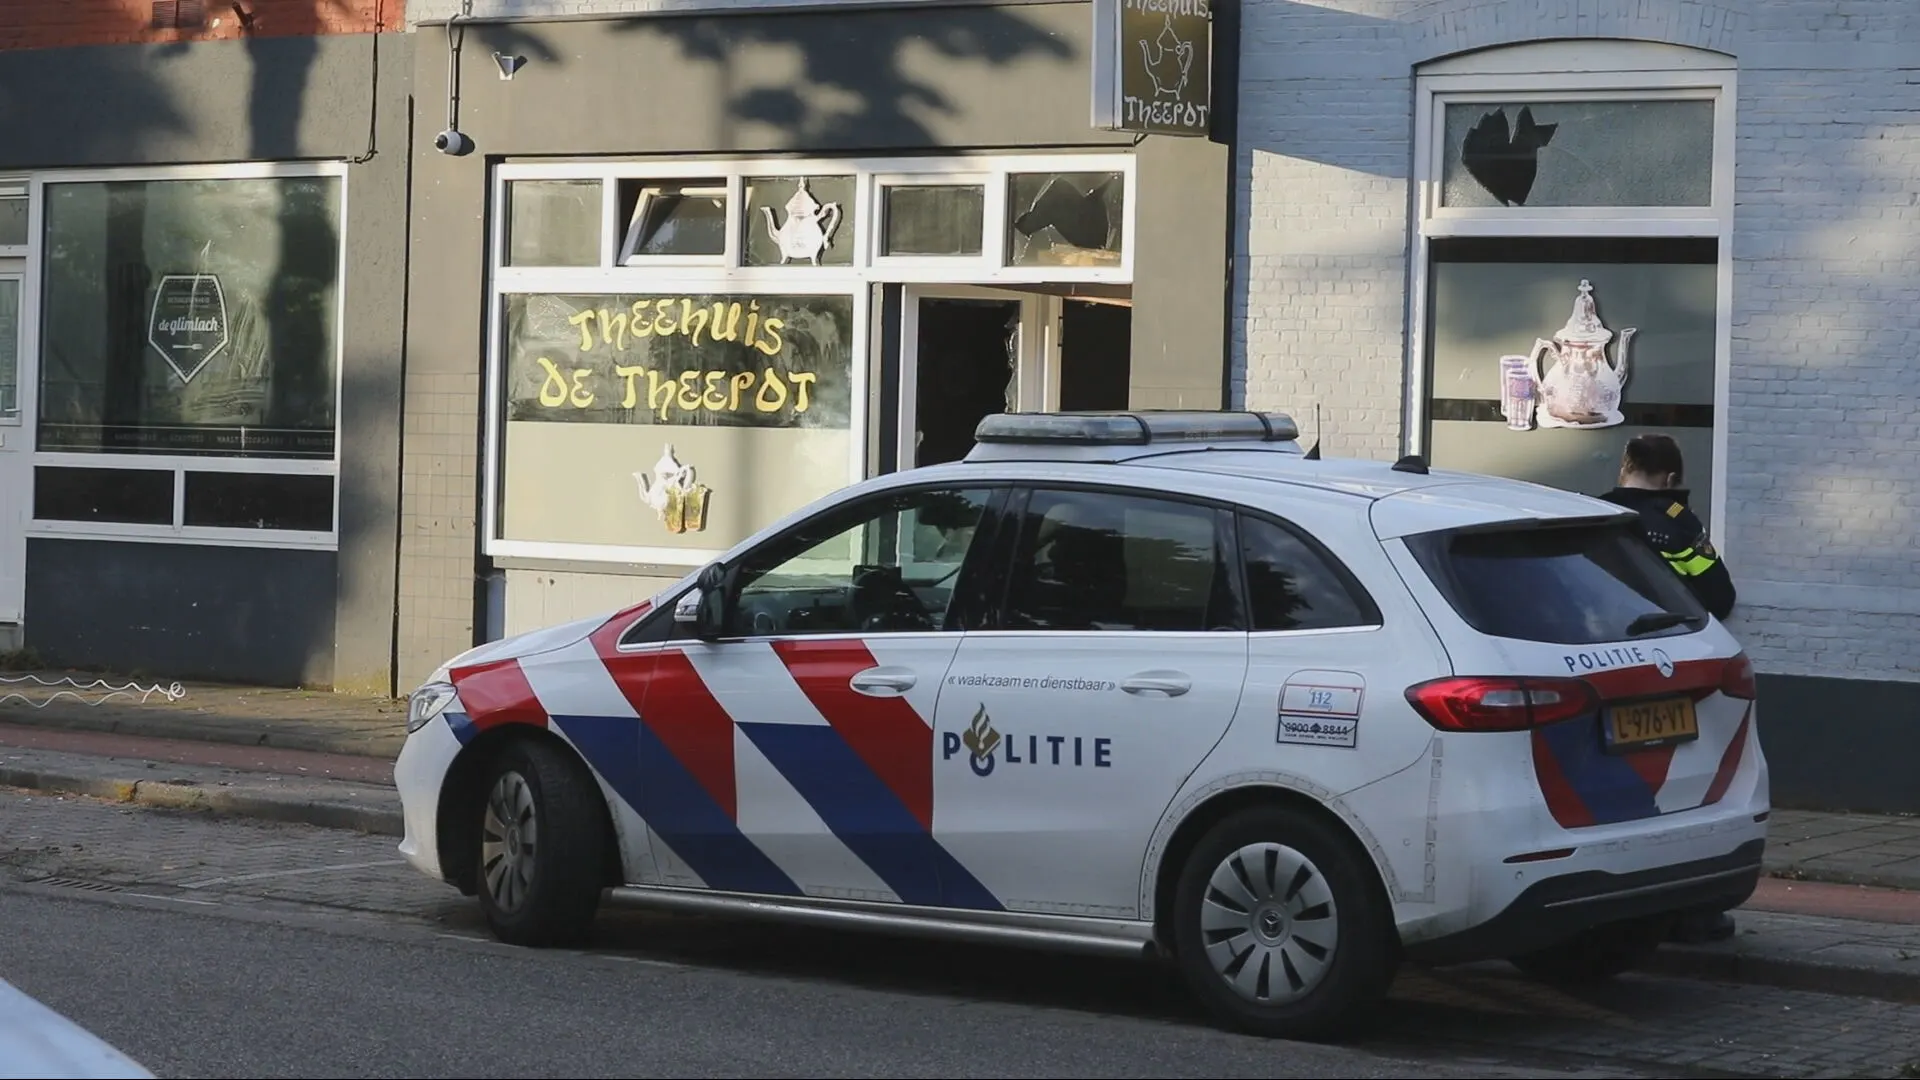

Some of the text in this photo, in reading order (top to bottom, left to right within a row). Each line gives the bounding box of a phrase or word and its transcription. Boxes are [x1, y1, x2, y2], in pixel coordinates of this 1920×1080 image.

[158, 316, 218, 336] de glimlach
[537, 357, 595, 408] DE
[1563, 647, 1646, 672] POLITIE
[957, 673, 1021, 687] waakzaam
[1023, 676, 1038, 688] en
[1040, 675, 1106, 691] dienstbaar
[1311, 691, 1332, 705] 112
[942, 731, 1112, 777] POLITIE
